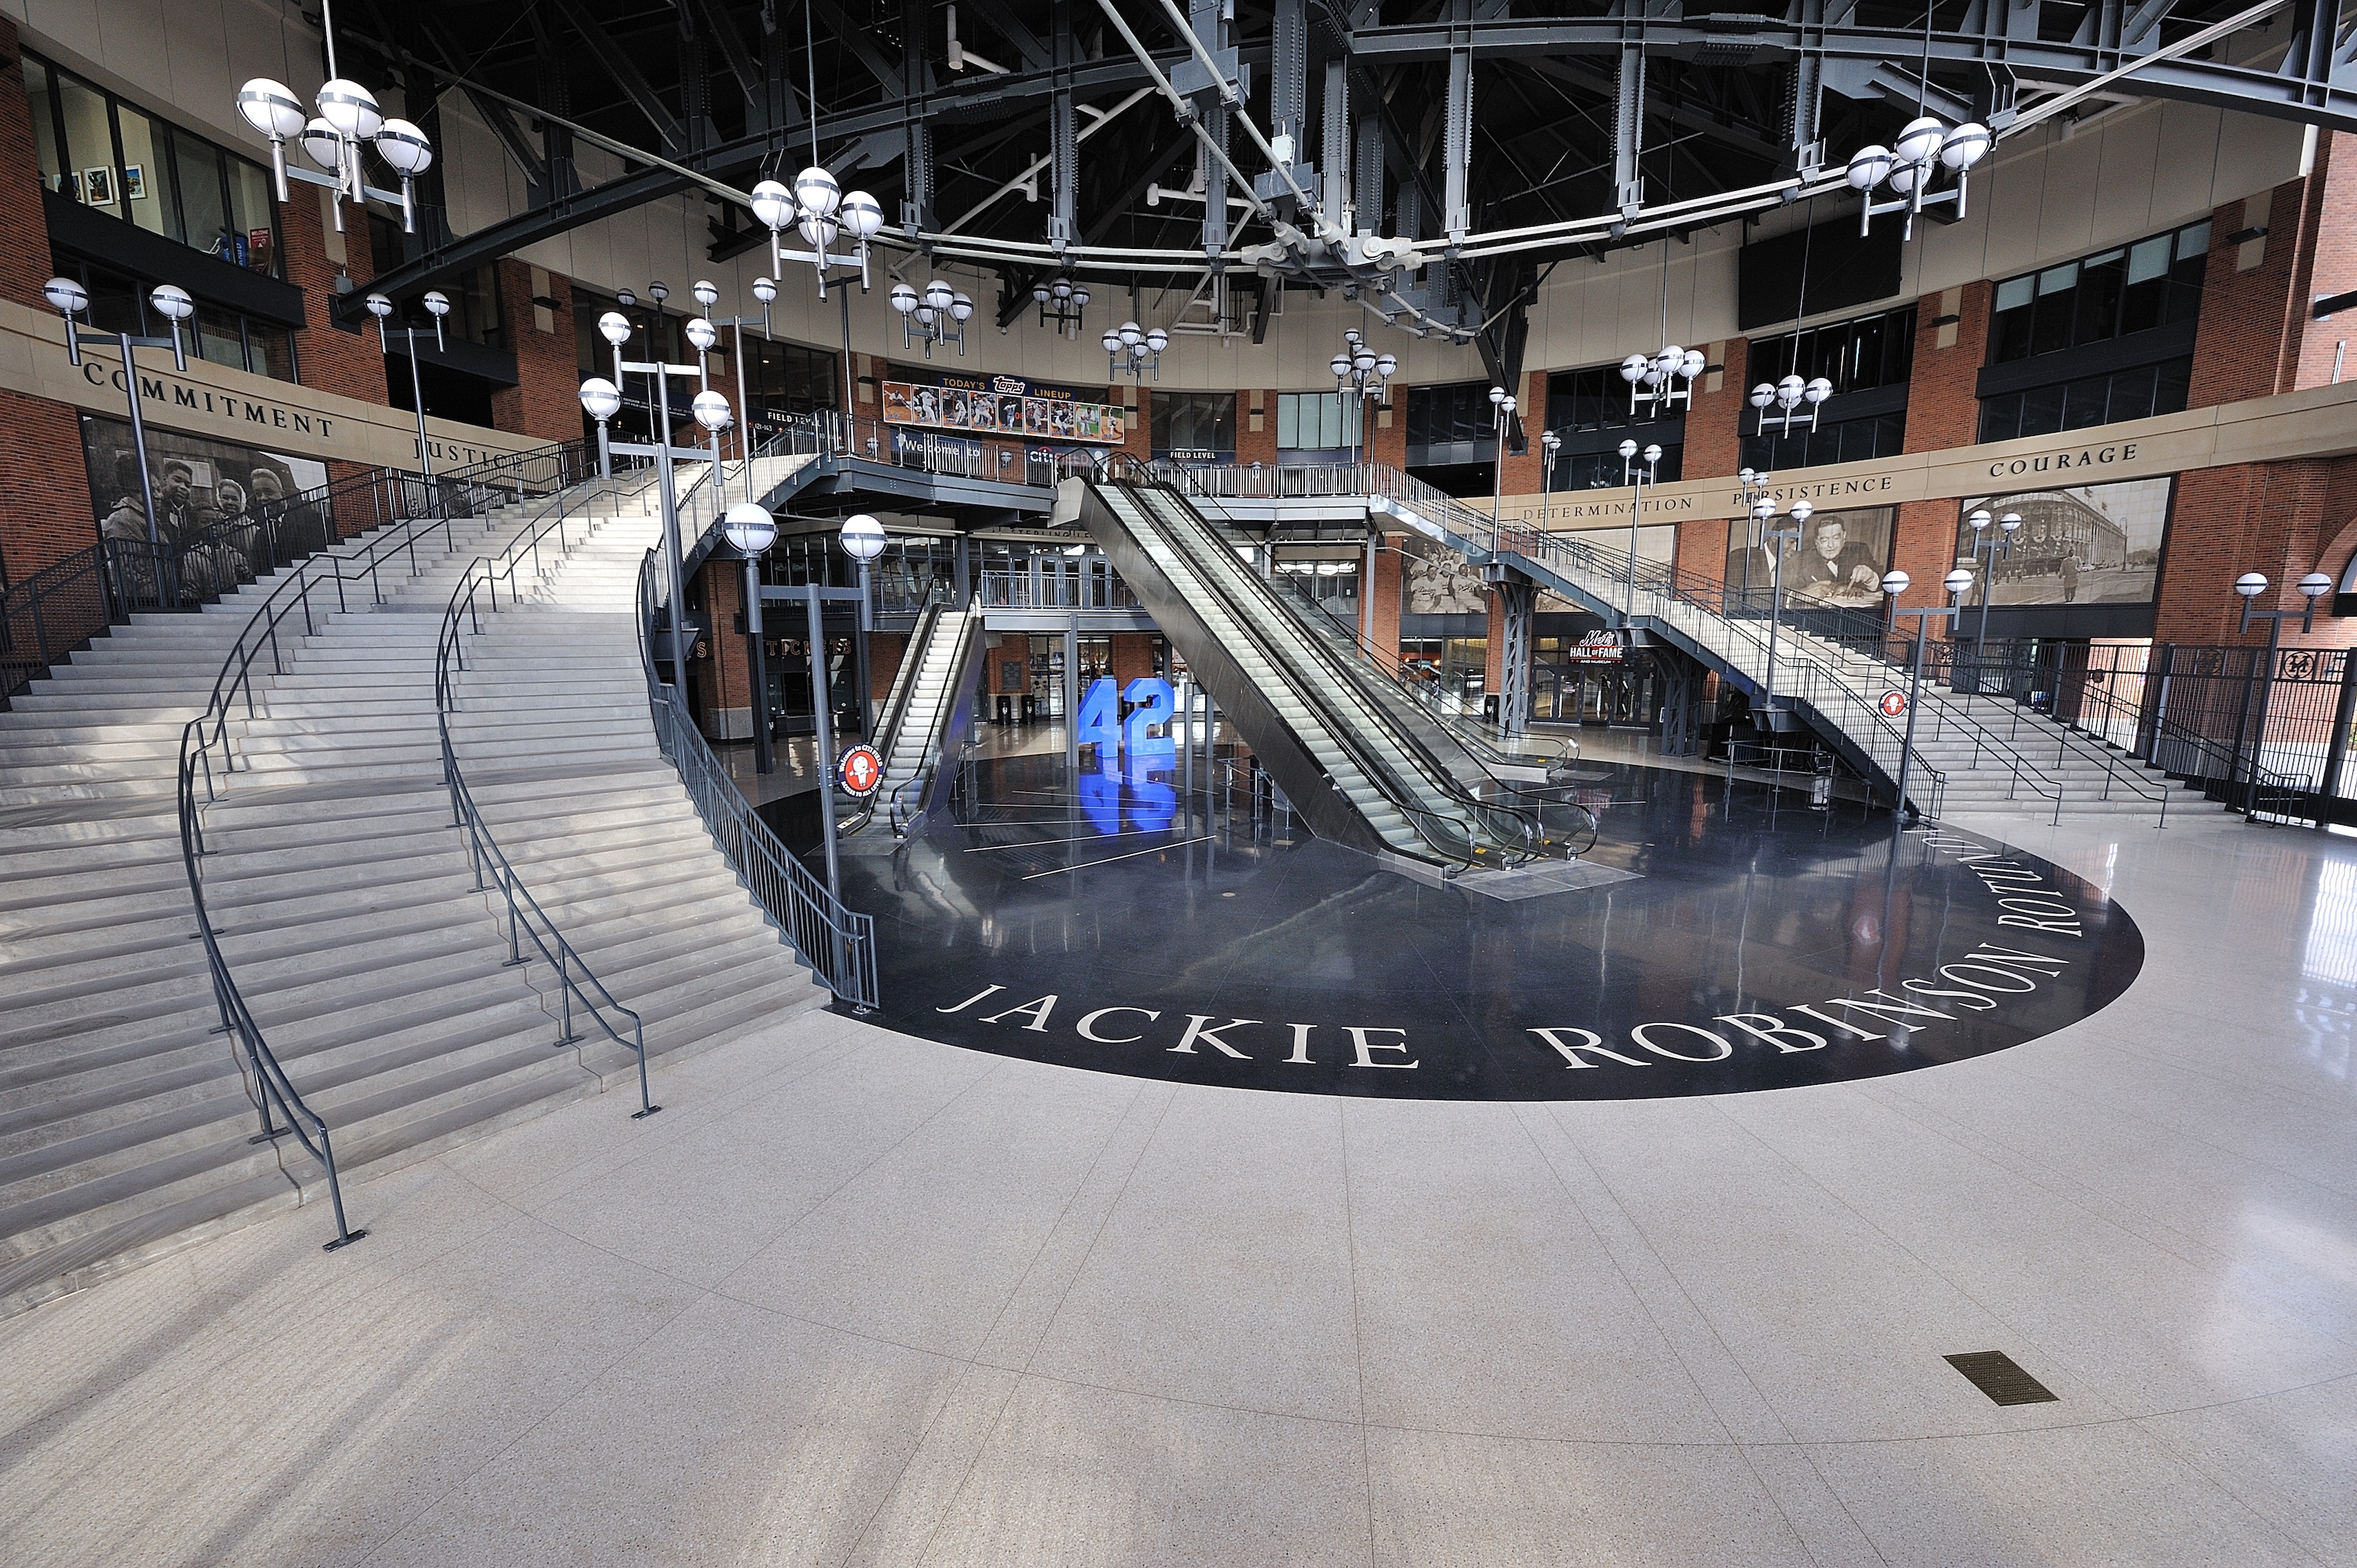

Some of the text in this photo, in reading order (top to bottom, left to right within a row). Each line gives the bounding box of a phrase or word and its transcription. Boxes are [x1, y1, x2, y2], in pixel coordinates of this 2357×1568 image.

[83, 362, 332, 437] COMMITMENT
[943, 378, 985, 390] TODAY'S
[1034, 388, 1071, 400] LINEUP
[768, 412, 792, 422] FIELD
[413, 438, 522, 471] JUSTICE
[905, 440, 959, 455] Wecome
[1990, 444, 2137, 477] COURAGE
[1733, 477, 1892, 504] PRSISTENCE
[1523, 497, 1692, 519] DETERMINATION
[1579, 630, 1615, 647] Mets
[1570, 647, 1592, 658] HALL
[1598, 647, 1623, 658] FAME
[1078, 677, 1175, 758] 42
[839, 748, 856, 772] Welcome
[872, 749, 883, 767] FIELD
[841, 781, 856, 796] ACCESS
[871, 774, 883, 792] LEVELS
[936, 829, 2082, 1069] JACKIE ROBINSON ROTUNDA
